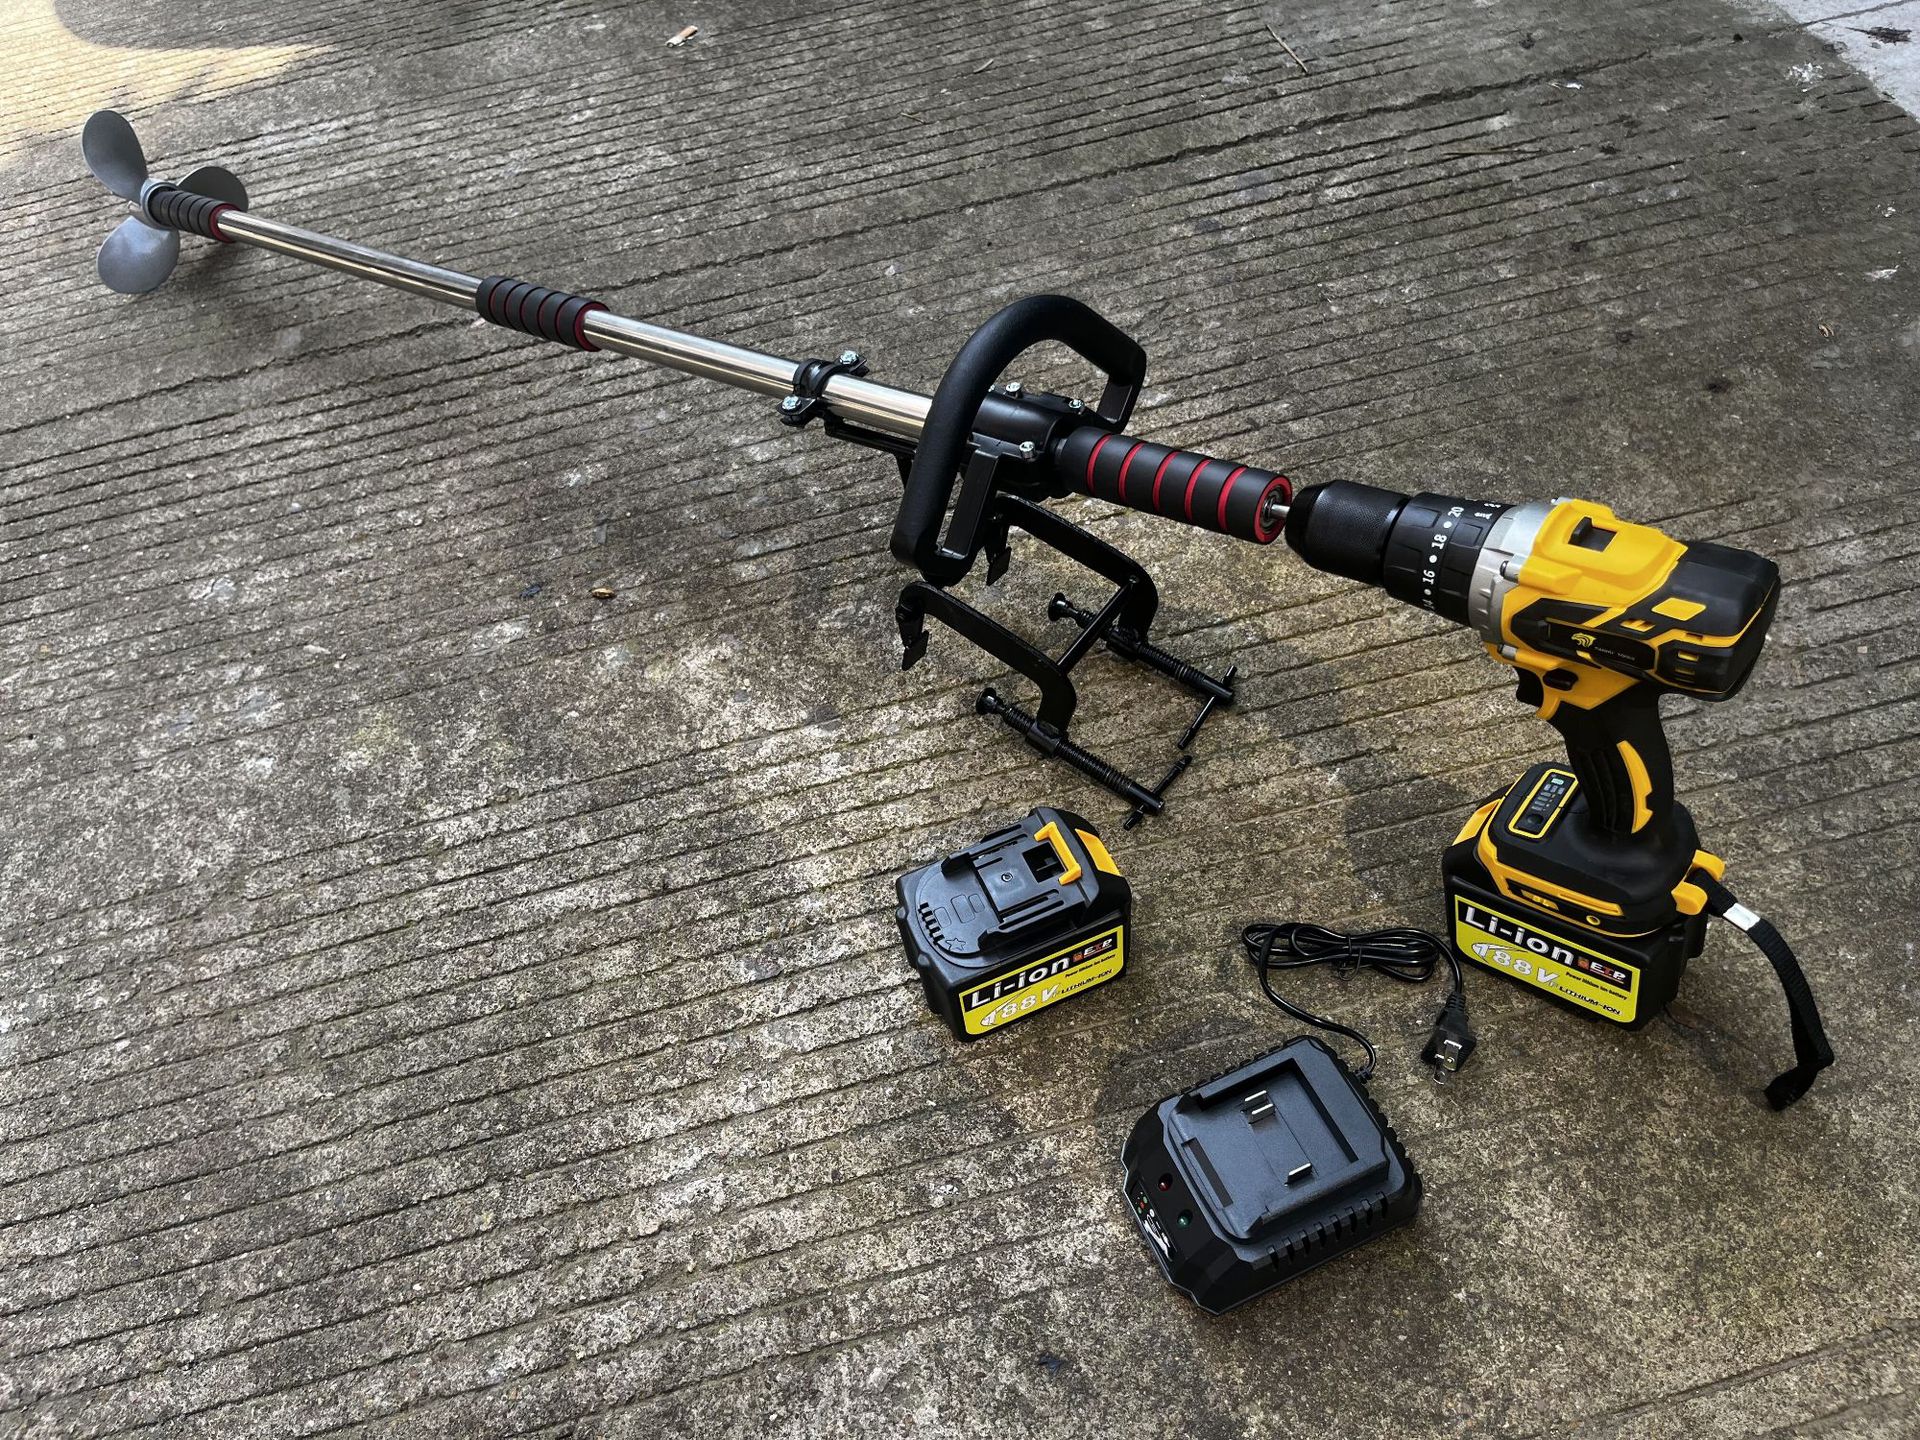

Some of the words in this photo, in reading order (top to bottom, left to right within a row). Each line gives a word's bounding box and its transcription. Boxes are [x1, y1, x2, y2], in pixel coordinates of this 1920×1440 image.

[1422, 569, 1435, 585] 16
[1431, 534, 1448, 550] 18
[1447, 506, 1464, 518] 20
[1465, 906, 1574, 966] Li-ion
[971, 957, 1069, 1008] Li-ion
